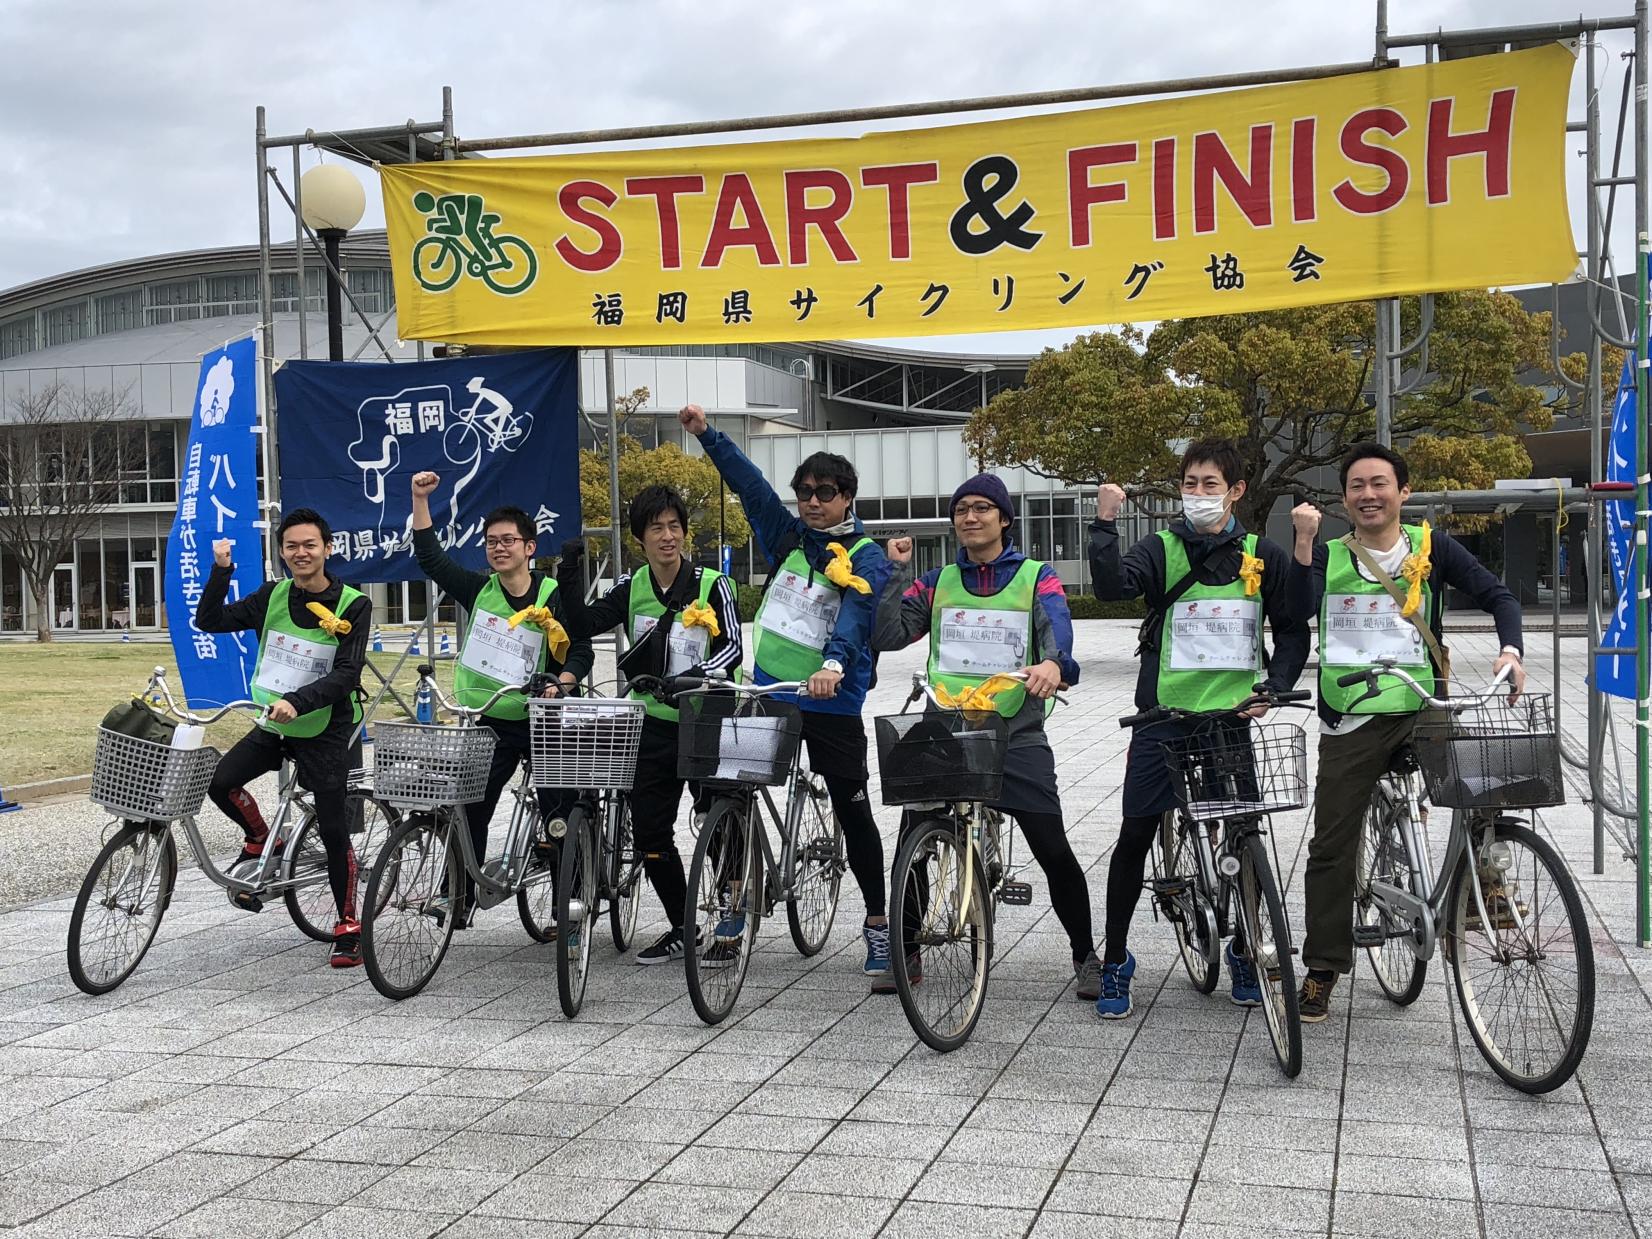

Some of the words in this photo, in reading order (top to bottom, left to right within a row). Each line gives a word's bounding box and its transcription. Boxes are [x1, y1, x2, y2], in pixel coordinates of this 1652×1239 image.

[553, 160, 940, 273] START
[949, 154, 1044, 256] &
[1067, 87, 1518, 248] FINISH
[591, 244, 1325, 326] 福岡県サイクリング協会
[384, 399, 445, 436] 福岡
